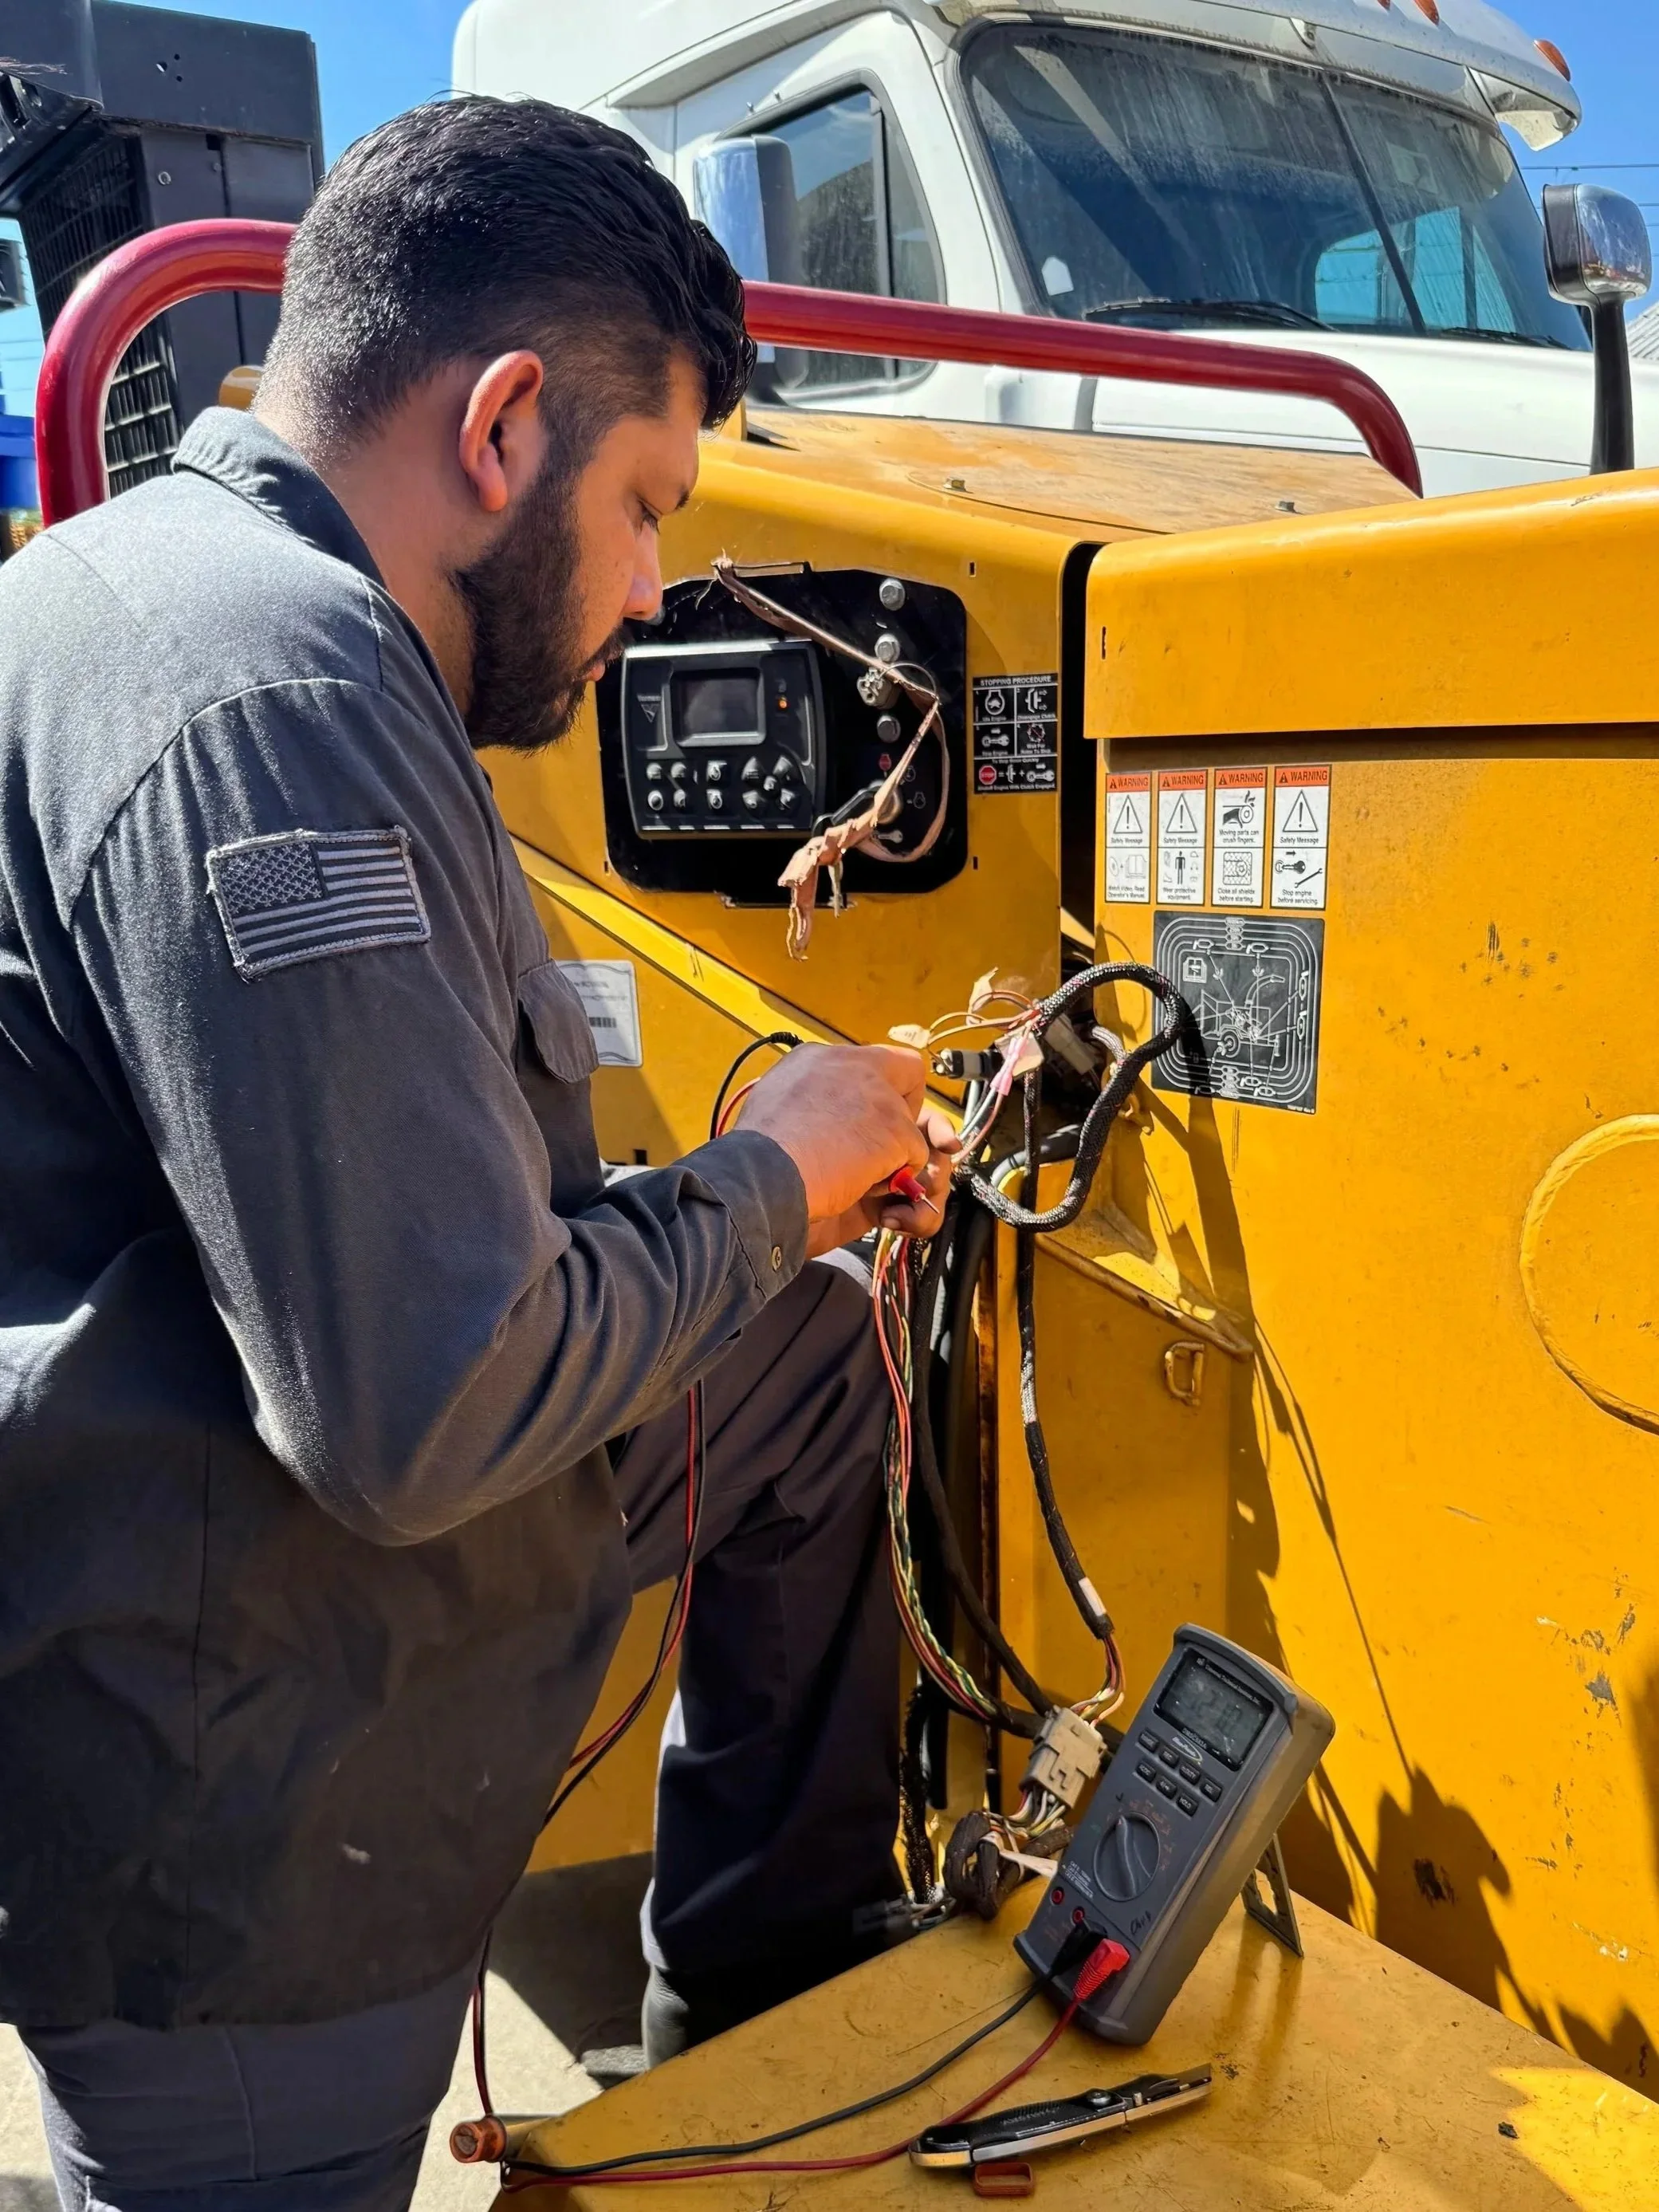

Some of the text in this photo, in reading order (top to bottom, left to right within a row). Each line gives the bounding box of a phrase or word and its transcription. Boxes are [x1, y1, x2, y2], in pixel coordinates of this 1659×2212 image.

[1012, 675, 1052, 684] PROCEDURE
[1171, 775, 1204, 785] WARNING
[1229, 773, 1263, 783] WARNING
[1291, 771, 1327, 781] WARNING
[1118, 777, 1148, 787] WARNING
